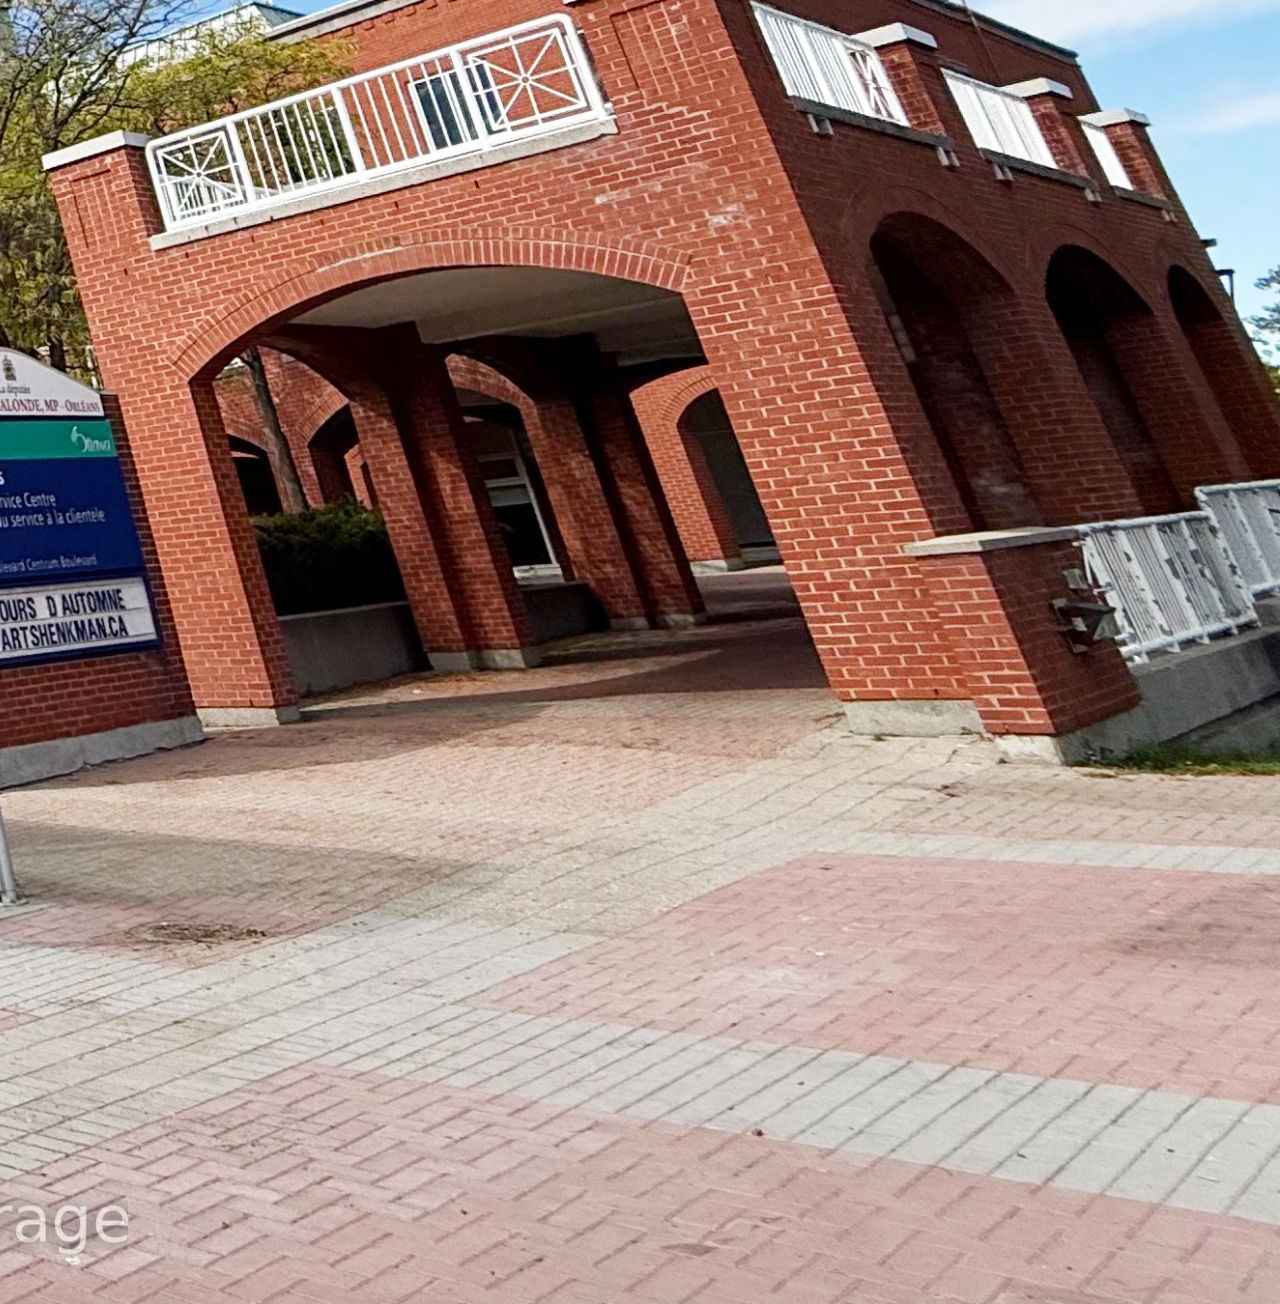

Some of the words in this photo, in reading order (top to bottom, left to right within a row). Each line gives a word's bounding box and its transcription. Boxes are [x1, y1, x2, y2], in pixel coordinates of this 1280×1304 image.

[45, 399, 59, 412] MP
[65, 400, 100, 412] ORLÉANS
[23, 492, 57, 508] Centre
[10, 510, 45, 527] service
[54, 509, 65, 525] la
[45, 595, 58, 617] D
[61, 588, 126, 615] AUTOMNE
[1, 615, 129, 652] ARTSHENKMAN.CA
